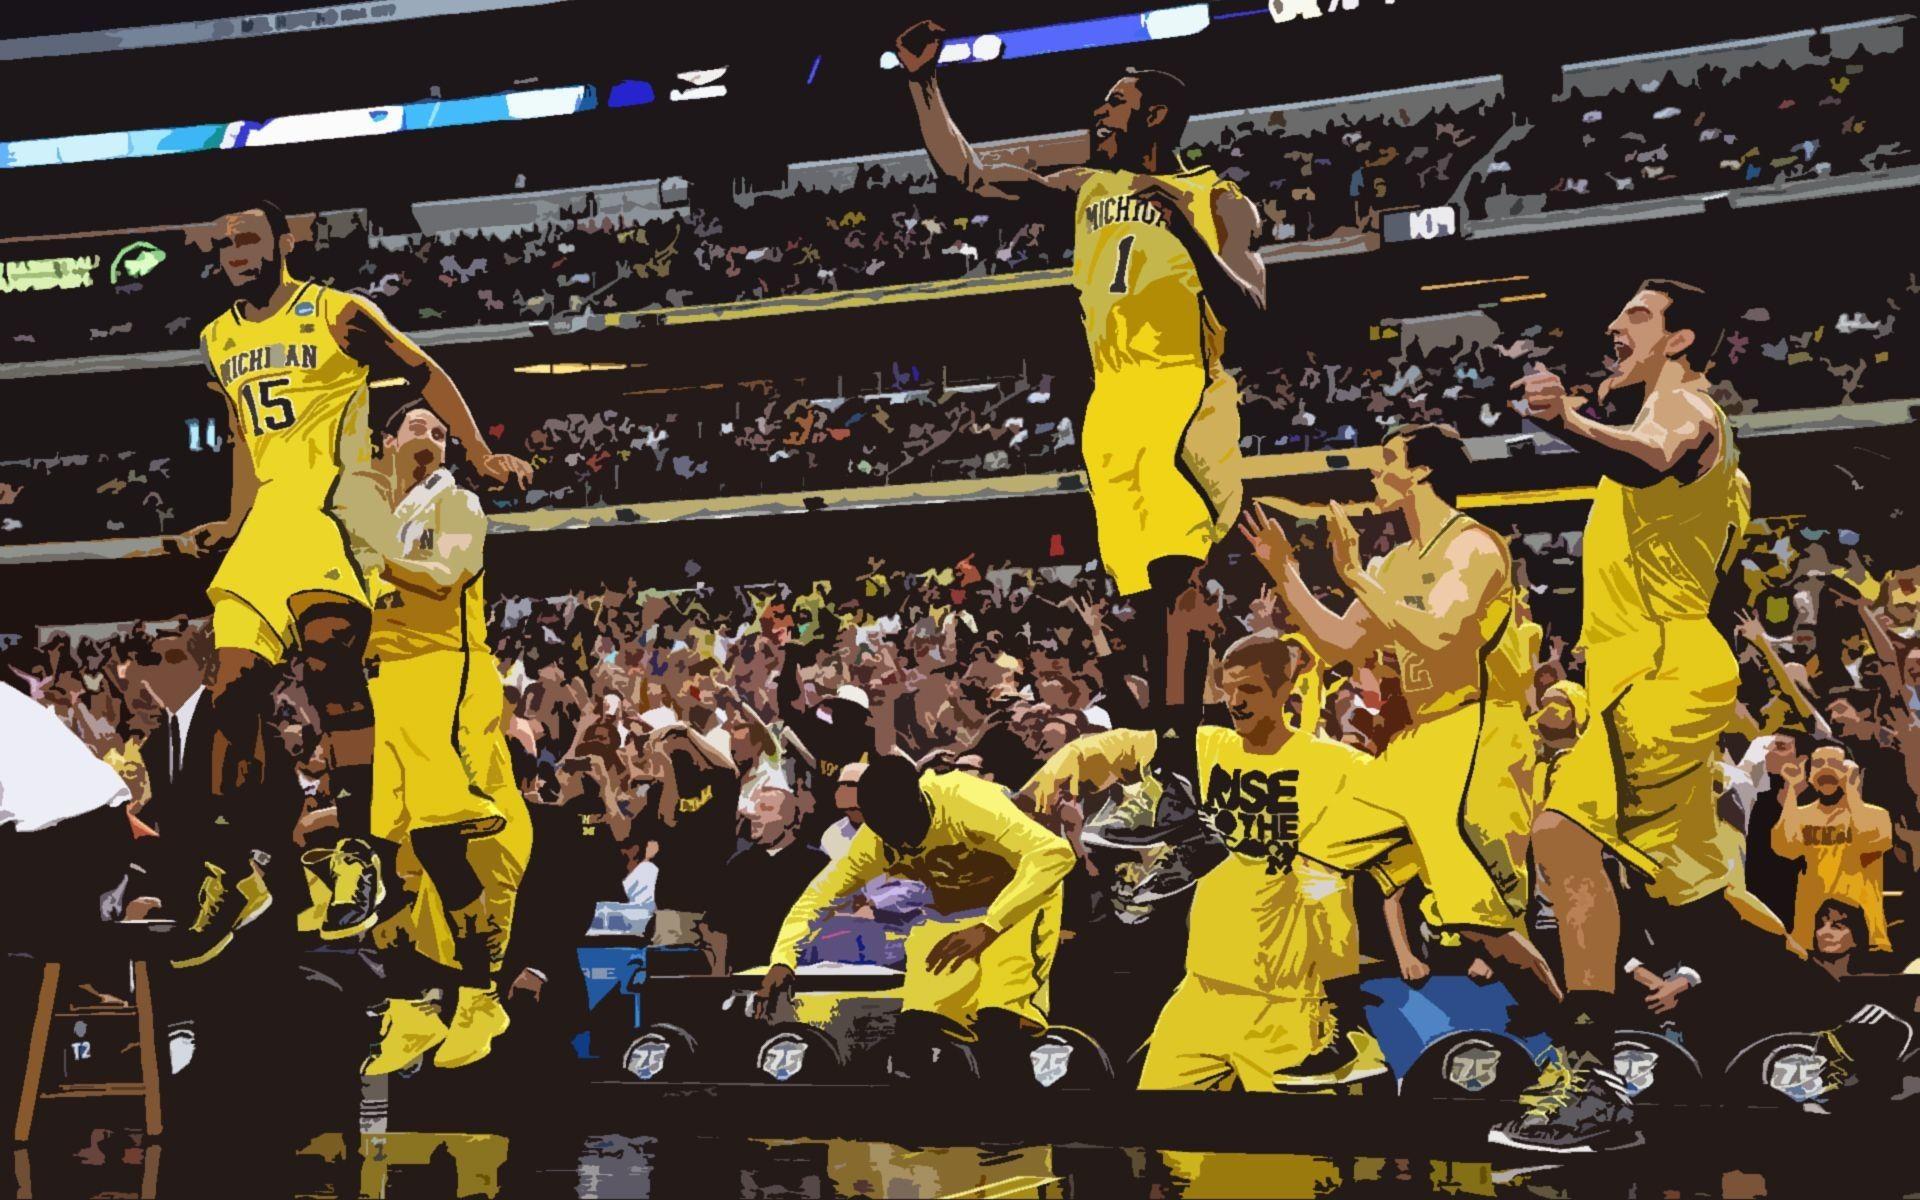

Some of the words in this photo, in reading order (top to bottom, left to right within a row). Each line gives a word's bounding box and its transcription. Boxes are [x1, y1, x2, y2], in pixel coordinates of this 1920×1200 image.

[1108, 234, 1135, 293] 1
[220, 343, 317, 387] MICHIAN
[241, 377, 297, 437] 15
[1237, 811, 1300, 841] THE
